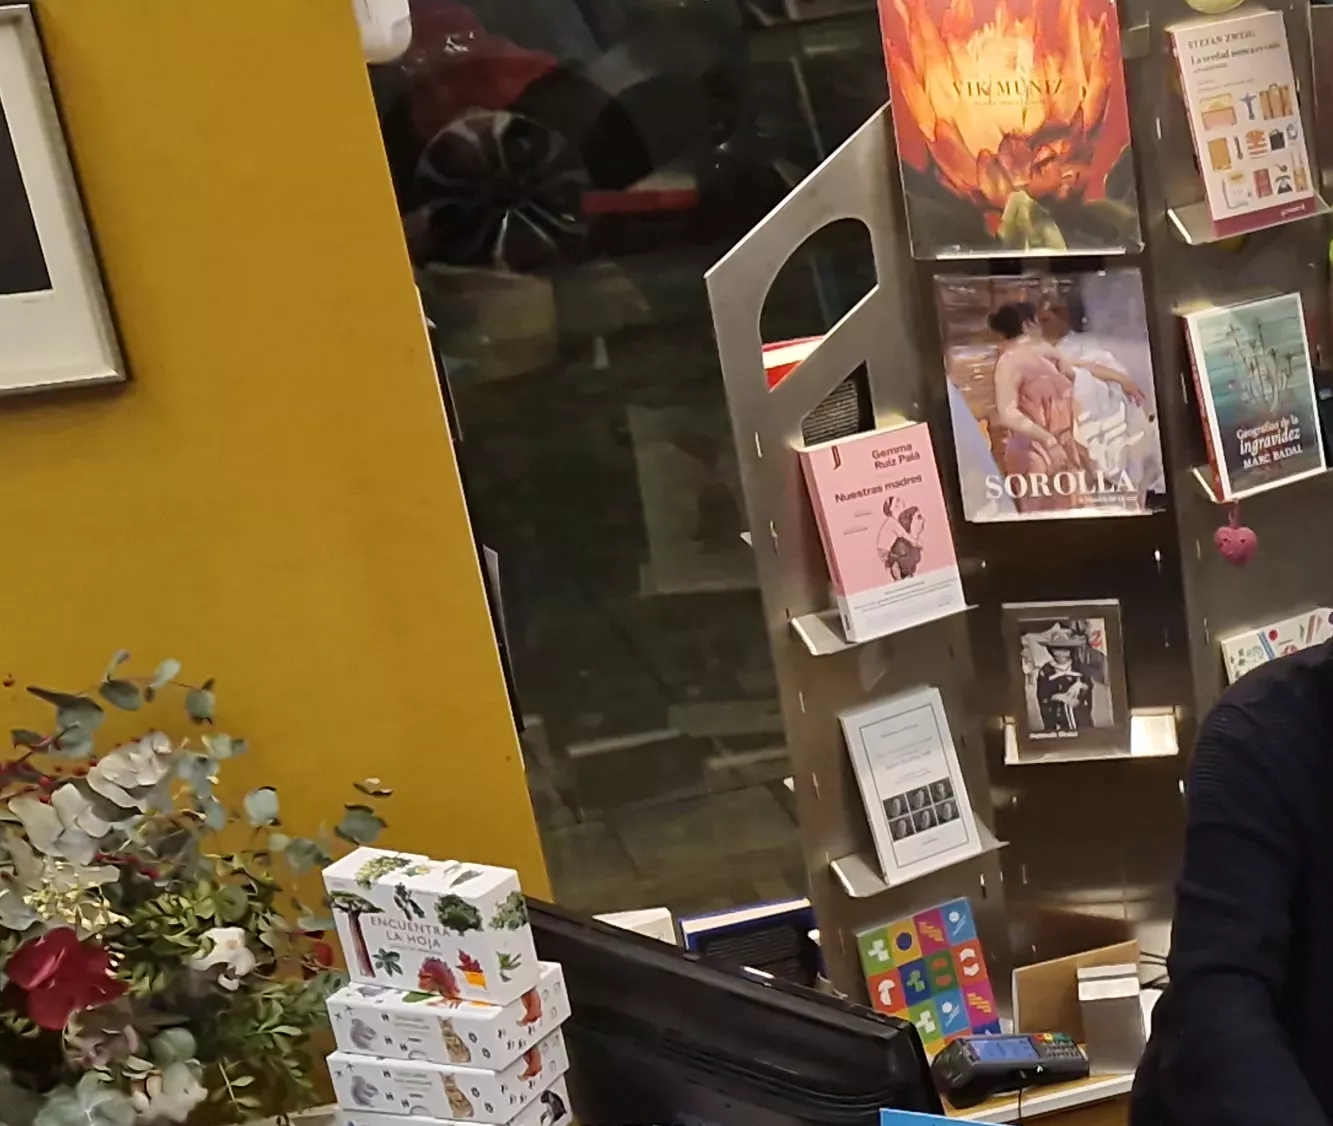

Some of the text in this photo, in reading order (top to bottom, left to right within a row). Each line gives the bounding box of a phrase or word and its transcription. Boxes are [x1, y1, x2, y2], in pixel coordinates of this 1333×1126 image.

[1188, 34, 1222, 49] STEFAN
[952, 78, 1064, 97] VIK MUNIZ
[871, 443, 913, 460] Gemma
[1239, 427, 1301, 457] ingravidez
[874, 457, 897, 470] Ruiz
[834, 474, 923, 504] Nuestras madres
[984, 468, 1137, 500] SOROLLA
[370, 915, 451, 938] ENCUENTRA
[386, 930, 441, 949] LA HOJA
